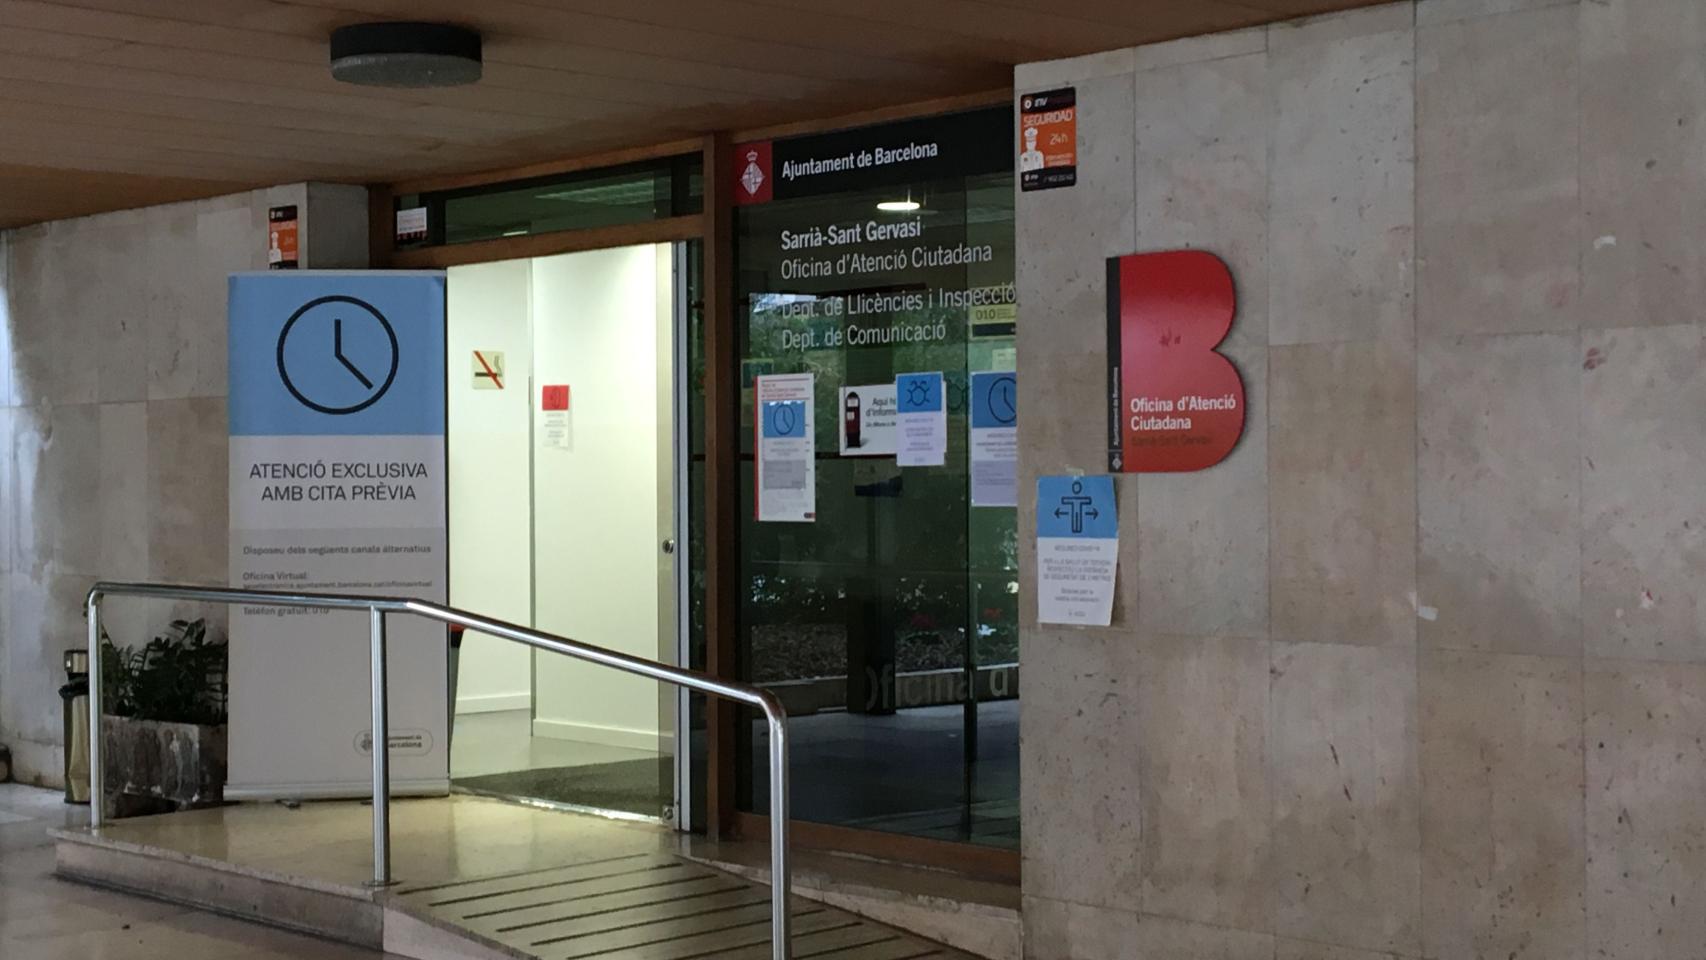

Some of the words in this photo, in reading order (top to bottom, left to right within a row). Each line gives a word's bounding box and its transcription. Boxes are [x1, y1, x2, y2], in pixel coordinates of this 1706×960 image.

[1023, 109, 1073, 128] SEGURIDAD
[1049, 133, 1068, 145] 24h
[781, 154, 855, 181] Ajuntament
[856, 150, 873, 168] de
[875, 141, 938, 166] Barcelona
[781, 224, 862, 250] Sarrià-Sant
[865, 215, 922, 241] Gervasi
[781, 256, 832, 280] Oficina
[836, 249, 908, 274] d'Atenció
[911, 243, 993, 268] Ciutadana
[781, 299, 821, 322] Dept.
[823, 296, 843, 317] de
[847, 289, 924, 316] Llicències
[927, 287, 933, 303] i
[938, 281, 1016, 312] Inspecció
[975, 308, 996, 321] 010
[781, 328, 821, 352] Dept.
[823, 323, 843, 344] de
[846, 314, 947, 344] Comunicació
[1130, 397, 1174, 413] Oficina
[1176, 393, 1237, 411] d'Atenció
[1130, 414, 1192, 431] Ciutadana
[249, 459, 326, 479] ATENCIÓ
[331, 462, 428, 478] EXCLUSIVA
[261, 485, 303, 501] AMB
[308, 485, 347, 501] CITA
[352, 482, 416, 500] PRÈVIA
[243, 546, 285, 556] Disposeu
[286, 546, 307, 554] dels
[308, 546, 349, 556] següents
[350, 545, 381, 554] canals
[382, 544, 432, 553] alternatius
[242, 571, 275, 581] Oficina
[243, 606, 276, 615] Telèfon
